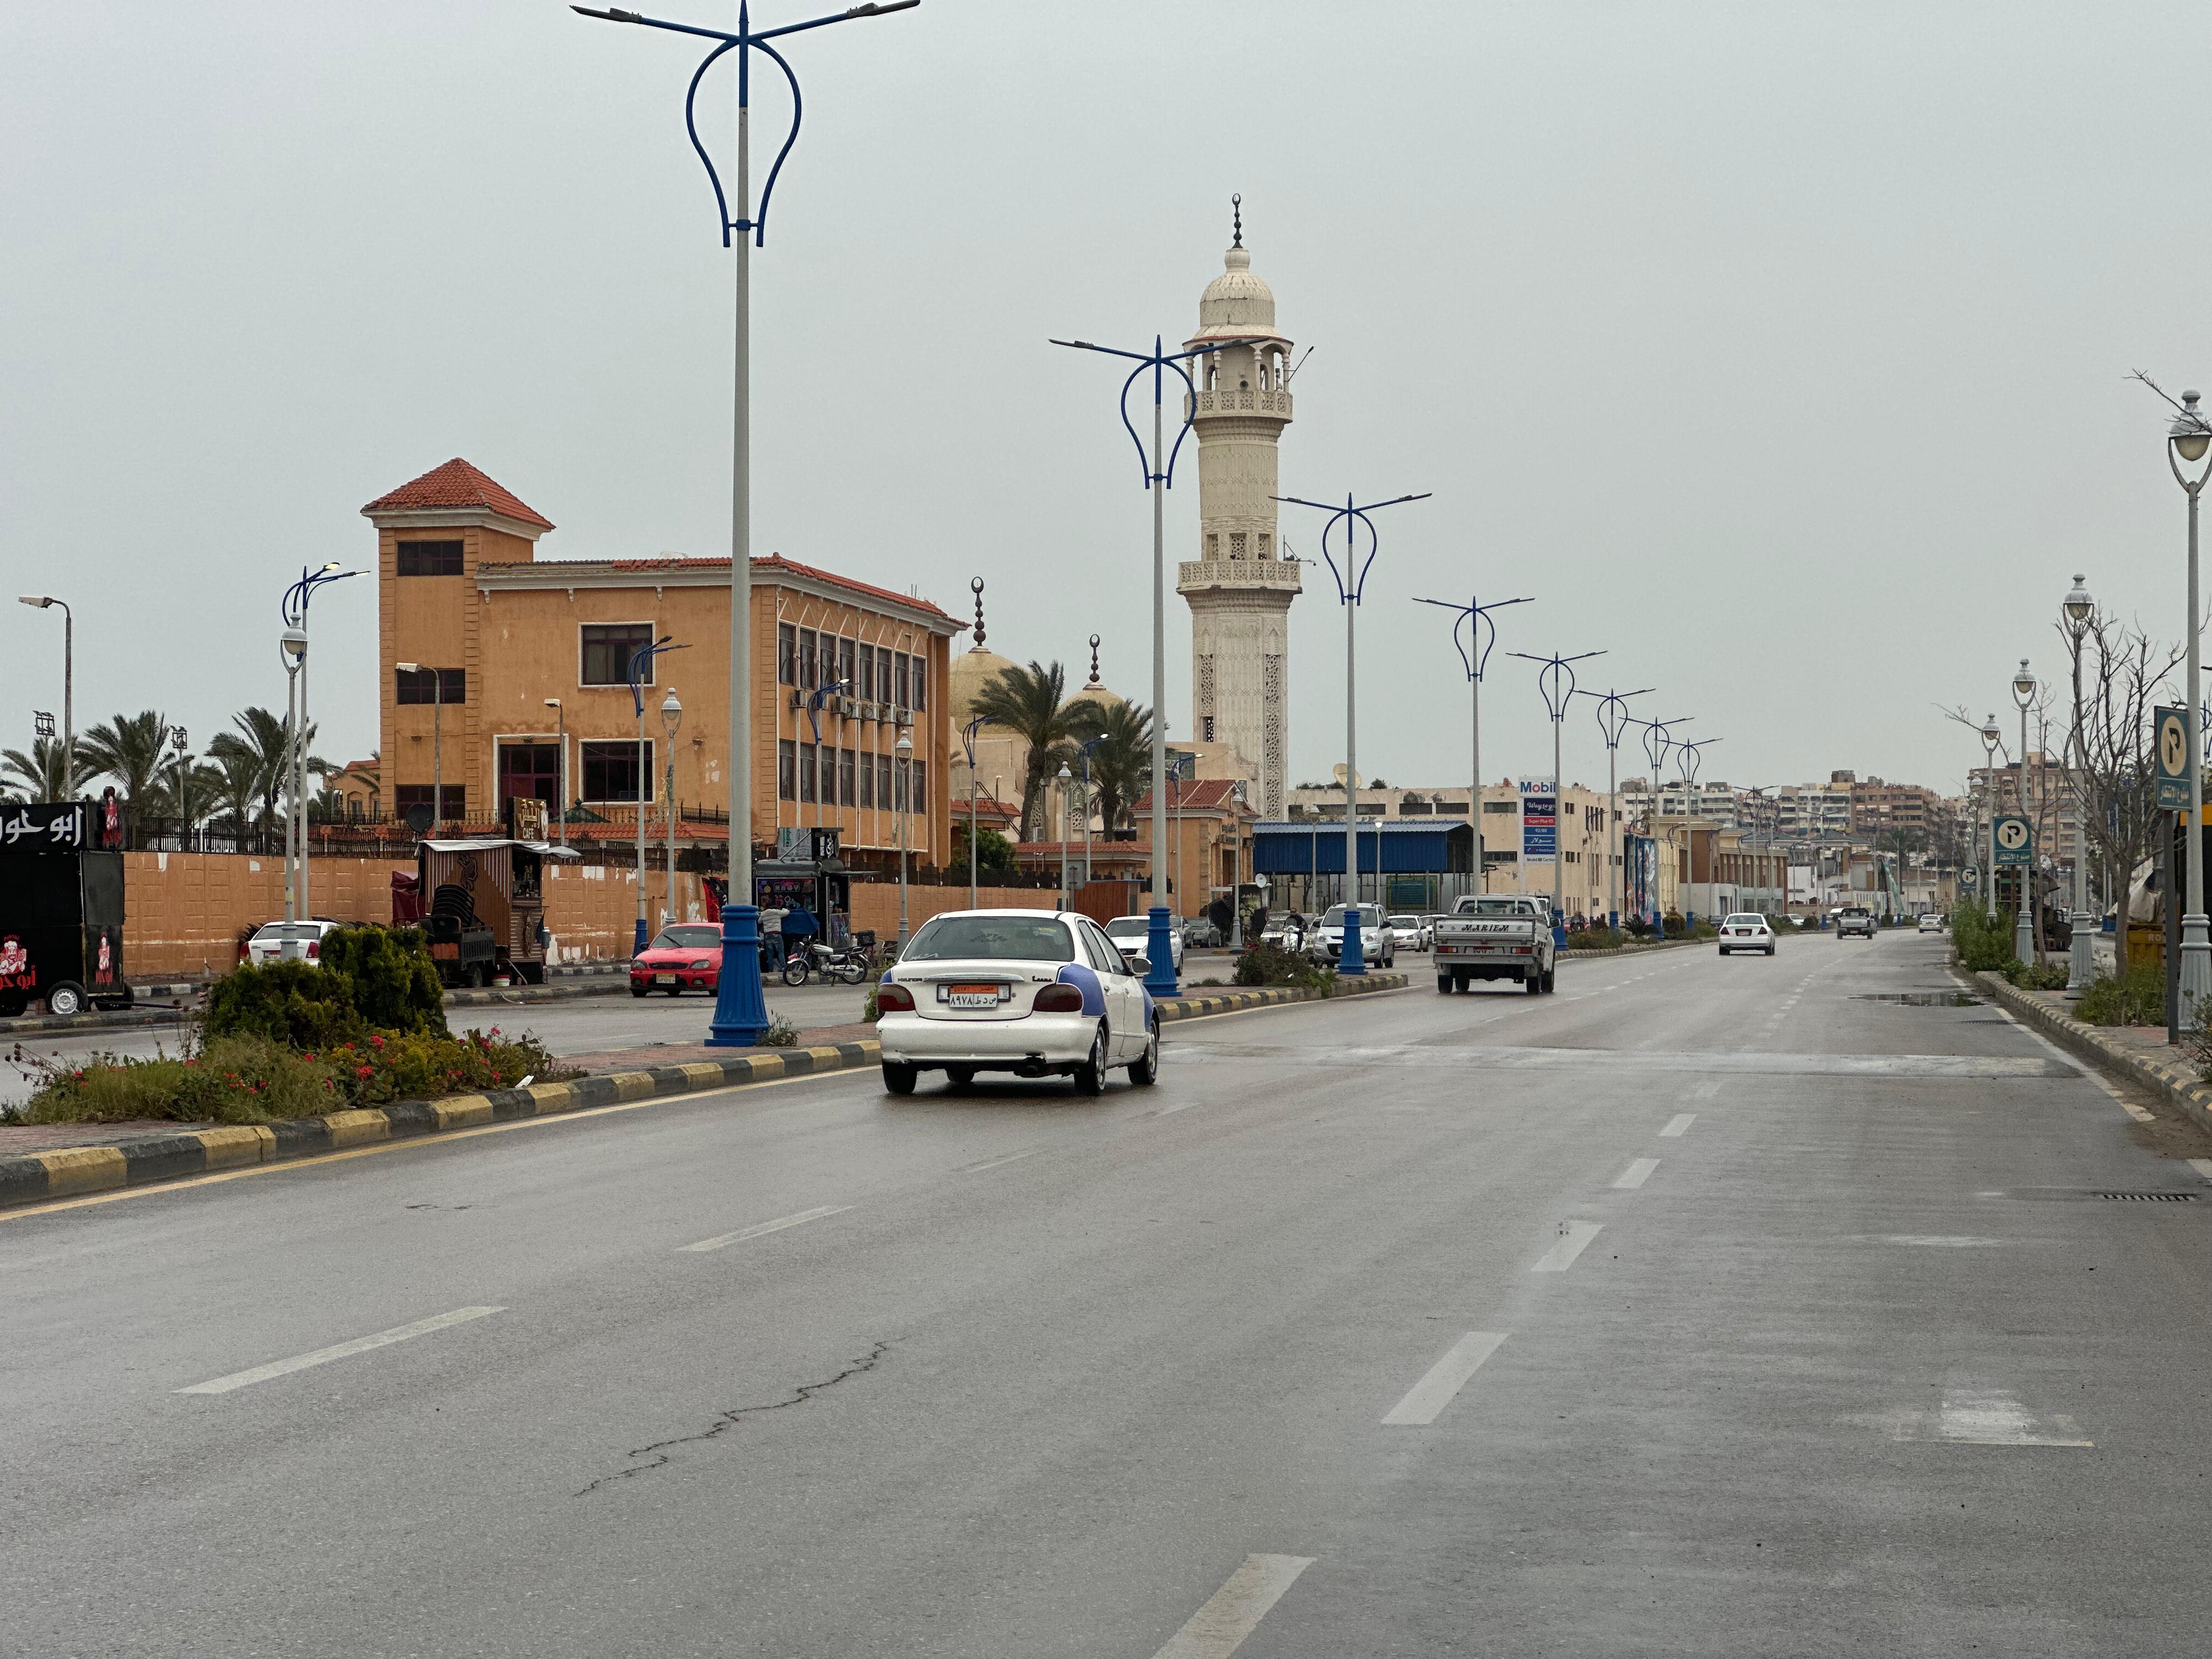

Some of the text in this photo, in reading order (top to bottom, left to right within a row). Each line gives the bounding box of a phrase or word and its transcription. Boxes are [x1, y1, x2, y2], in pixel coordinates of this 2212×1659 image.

[1520, 781, 1556, 793] Mobil
[522, 827, 534, 839] CAFE
[950, 995, 973, 1005] ٨٩٧٨
